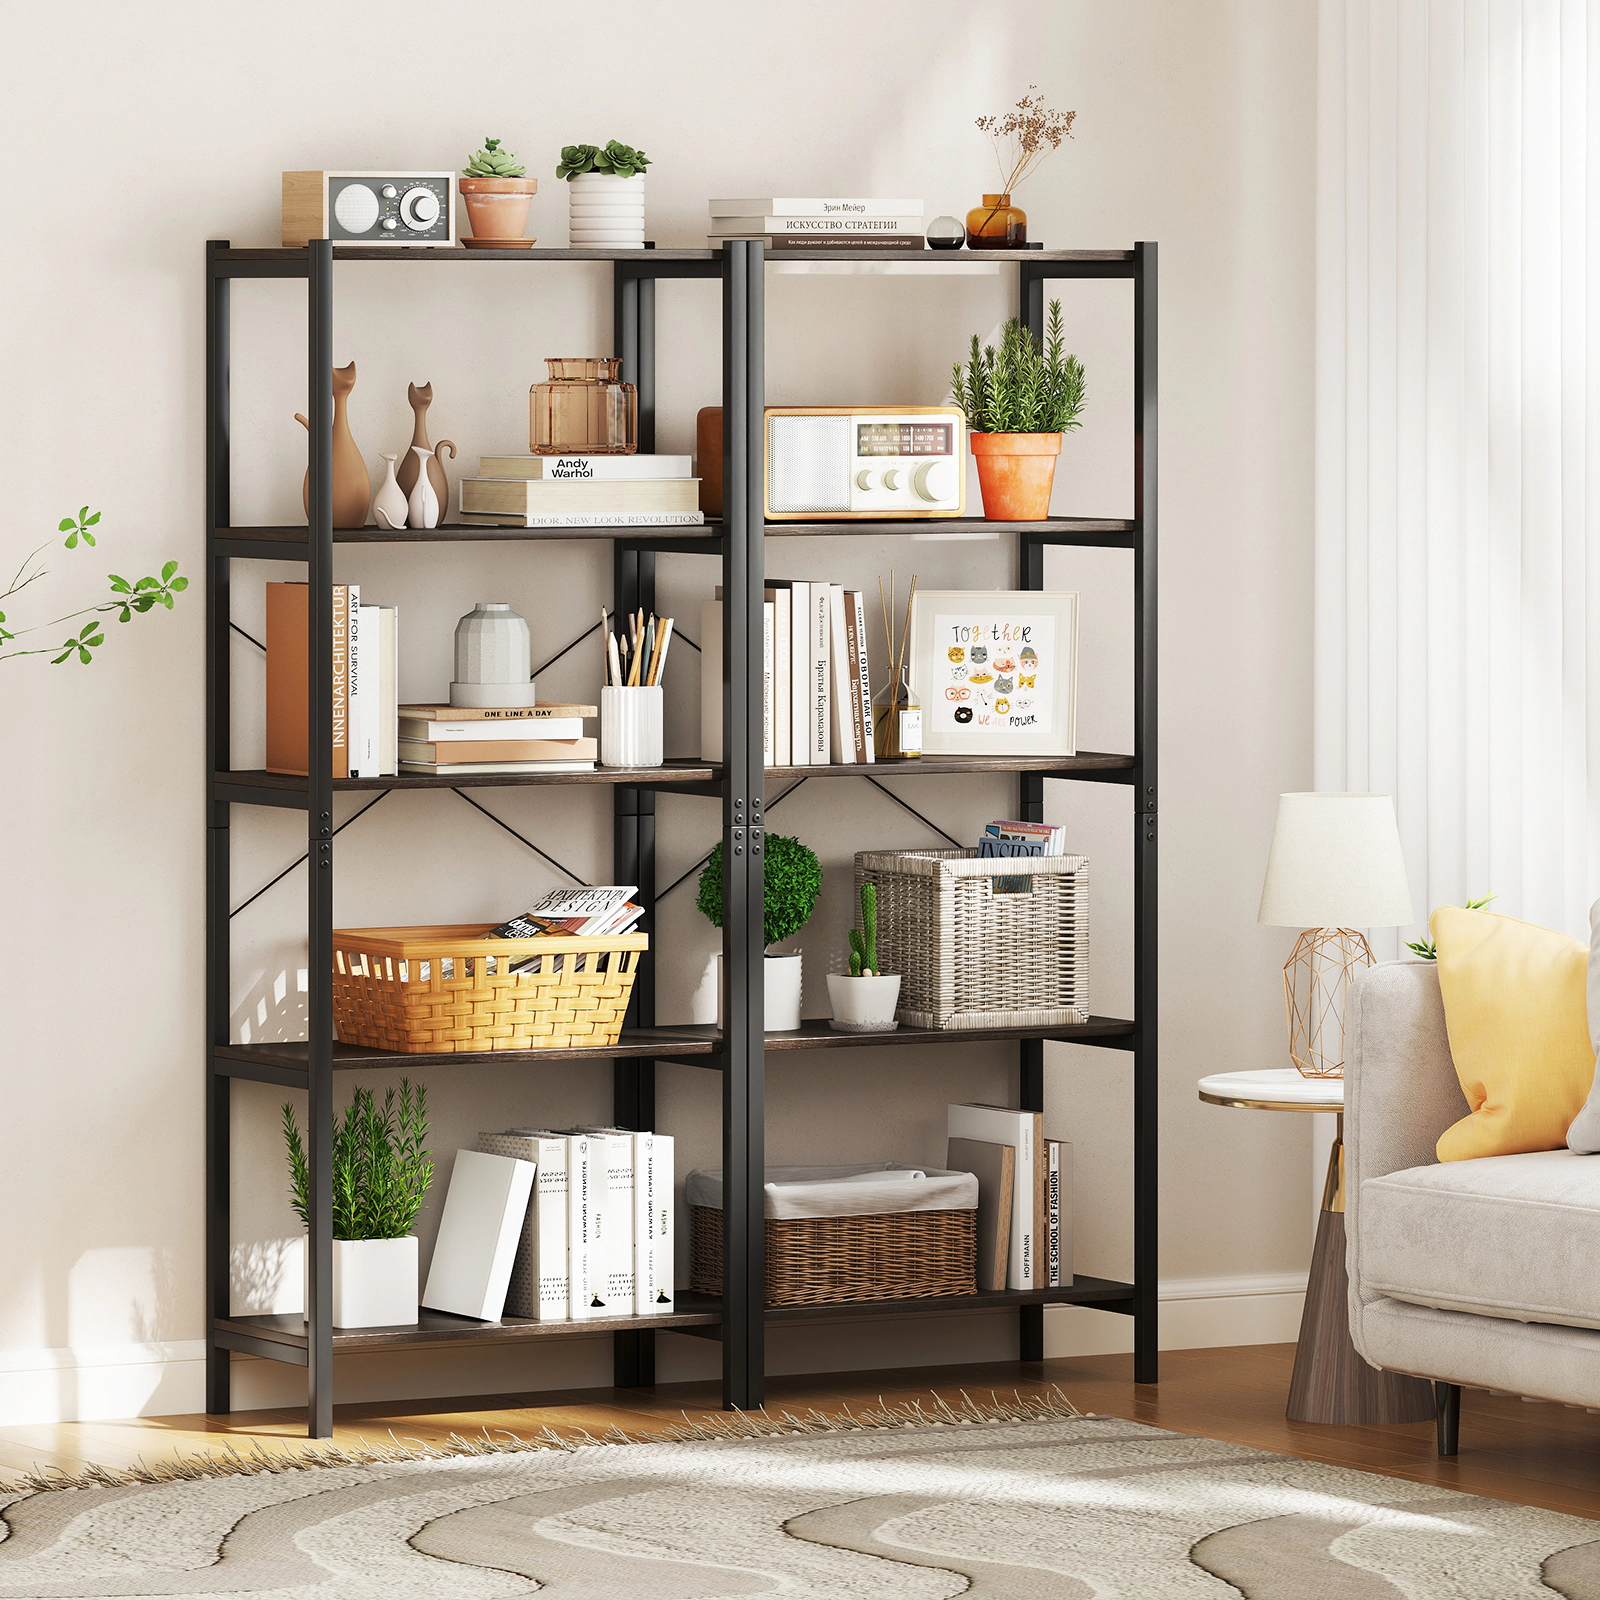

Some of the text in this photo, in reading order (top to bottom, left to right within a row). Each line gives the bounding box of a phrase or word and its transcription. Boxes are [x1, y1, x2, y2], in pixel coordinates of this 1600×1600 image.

[823, 203, 865, 212] Эрин Мейер
[786, 220, 897, 230] ИСКУССТВО СТРАТЕГИИ
[557, 458, 588, 470] Andy
[551, 469, 593, 478] Warhol
[628, 515, 699, 523] REVOLUTION
[333, 586, 345, 748] INNENARCHITEKTUR
[815, 660, 826, 692] Братья
[860, 652, 869, 696] ГОВОРИ
[815, 695, 826, 752] Карамазовы
[536, 901, 616, 912] DESIGN
[1050, 1170, 1059, 1283] THE SCHOOL OF FASHION
